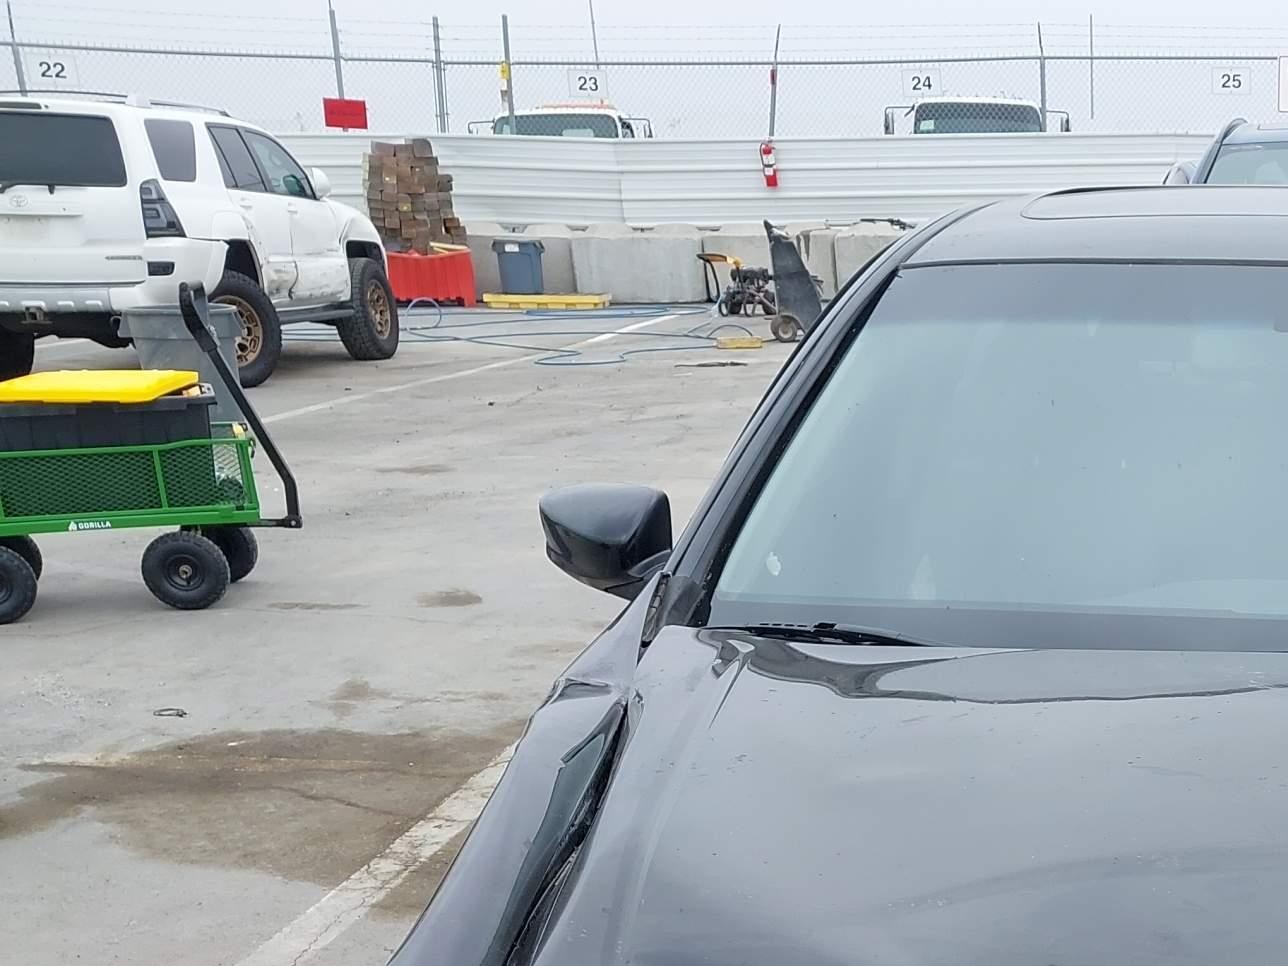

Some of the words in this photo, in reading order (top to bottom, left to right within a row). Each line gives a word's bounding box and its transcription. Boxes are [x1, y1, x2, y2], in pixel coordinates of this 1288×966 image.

[39, 61, 67, 79] 22
[577, 75, 599, 92] 23
[911, 75, 933, 92] 24
[1221, 73, 1242, 89] 25
[78, 520, 112, 530] GORILLA
